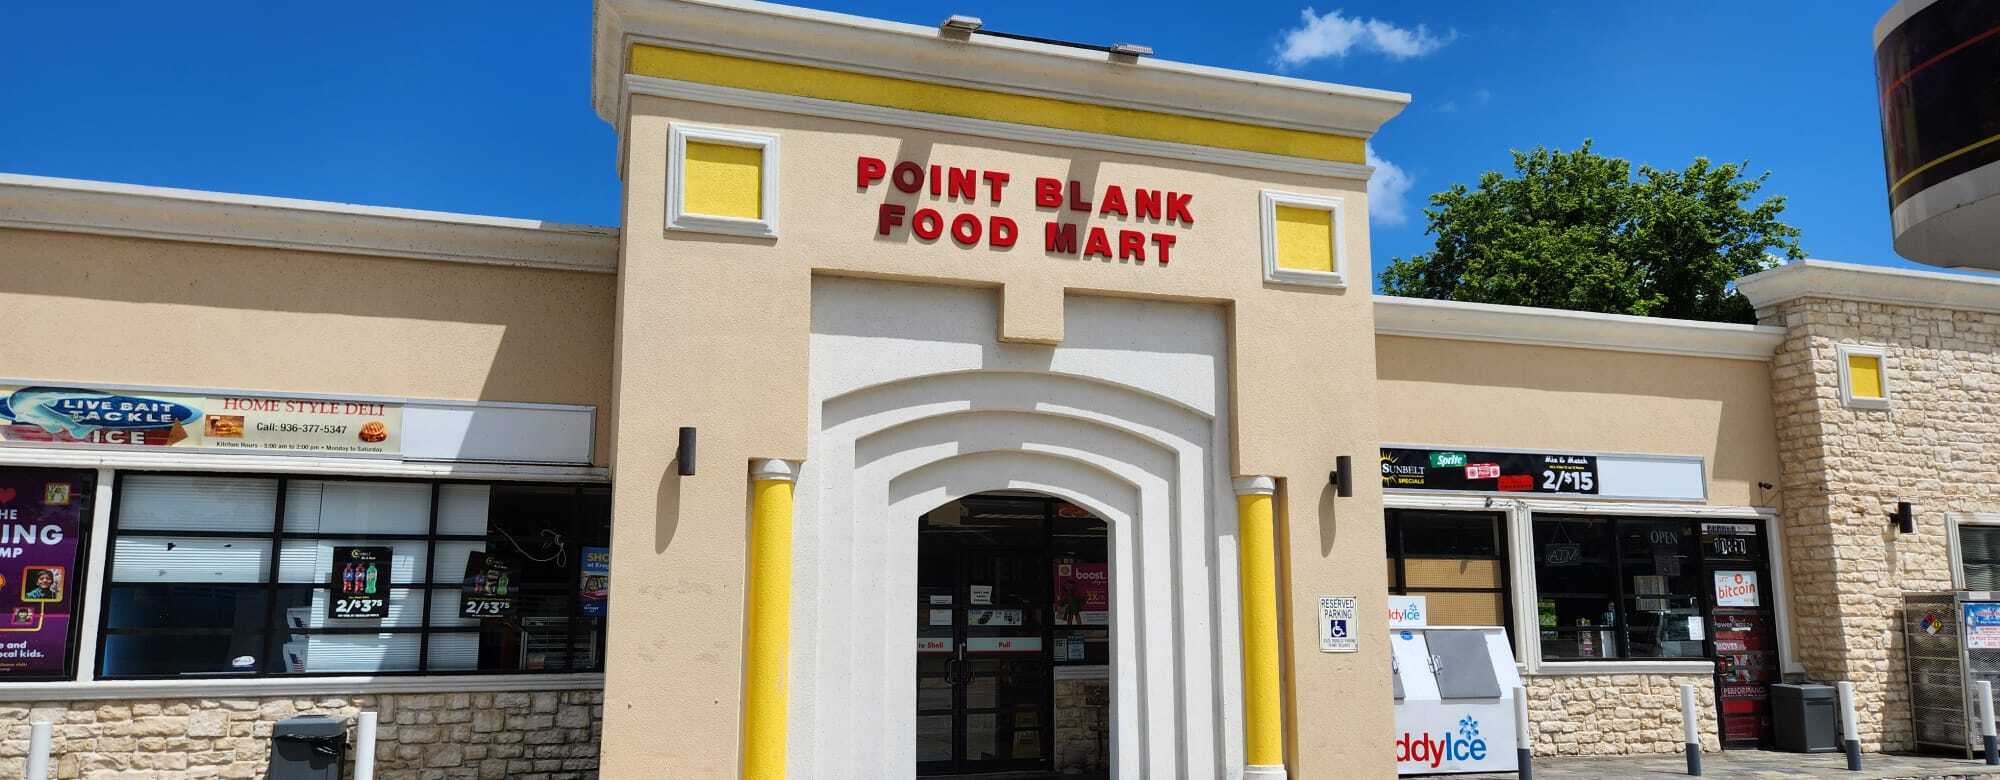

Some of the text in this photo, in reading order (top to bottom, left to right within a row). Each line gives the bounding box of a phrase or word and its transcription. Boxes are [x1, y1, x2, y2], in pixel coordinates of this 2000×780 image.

[857, 156, 1195, 224] POINT BLANK
[879, 203, 1177, 264] FOOD MART
[64, 399, 175, 412] LIVE BAIT
[223, 397, 385, 417] HOME STYLE DELI
[69, 410, 173, 423] TACKLE
[256, 422, 347, 434] Call: 936-377-5347
[92, 430, 145, 445] ICE
[1437, 455, 1463, 466] Sprite
[1382, 463, 1425, 475] SUNBELT
[1542, 470, 1594, 491] 2/$15
[1, 523, 64, 546] ING
[1718, 580, 1757, 599] bitcoin
[1321, 598, 1355, 609] RESERVED
[1324, 609, 1353, 619] PARKING
[6, 639, 27, 649] and
[20, 649, 45, 658] kids.
[1396, 732, 1487, 768] ddyIce
